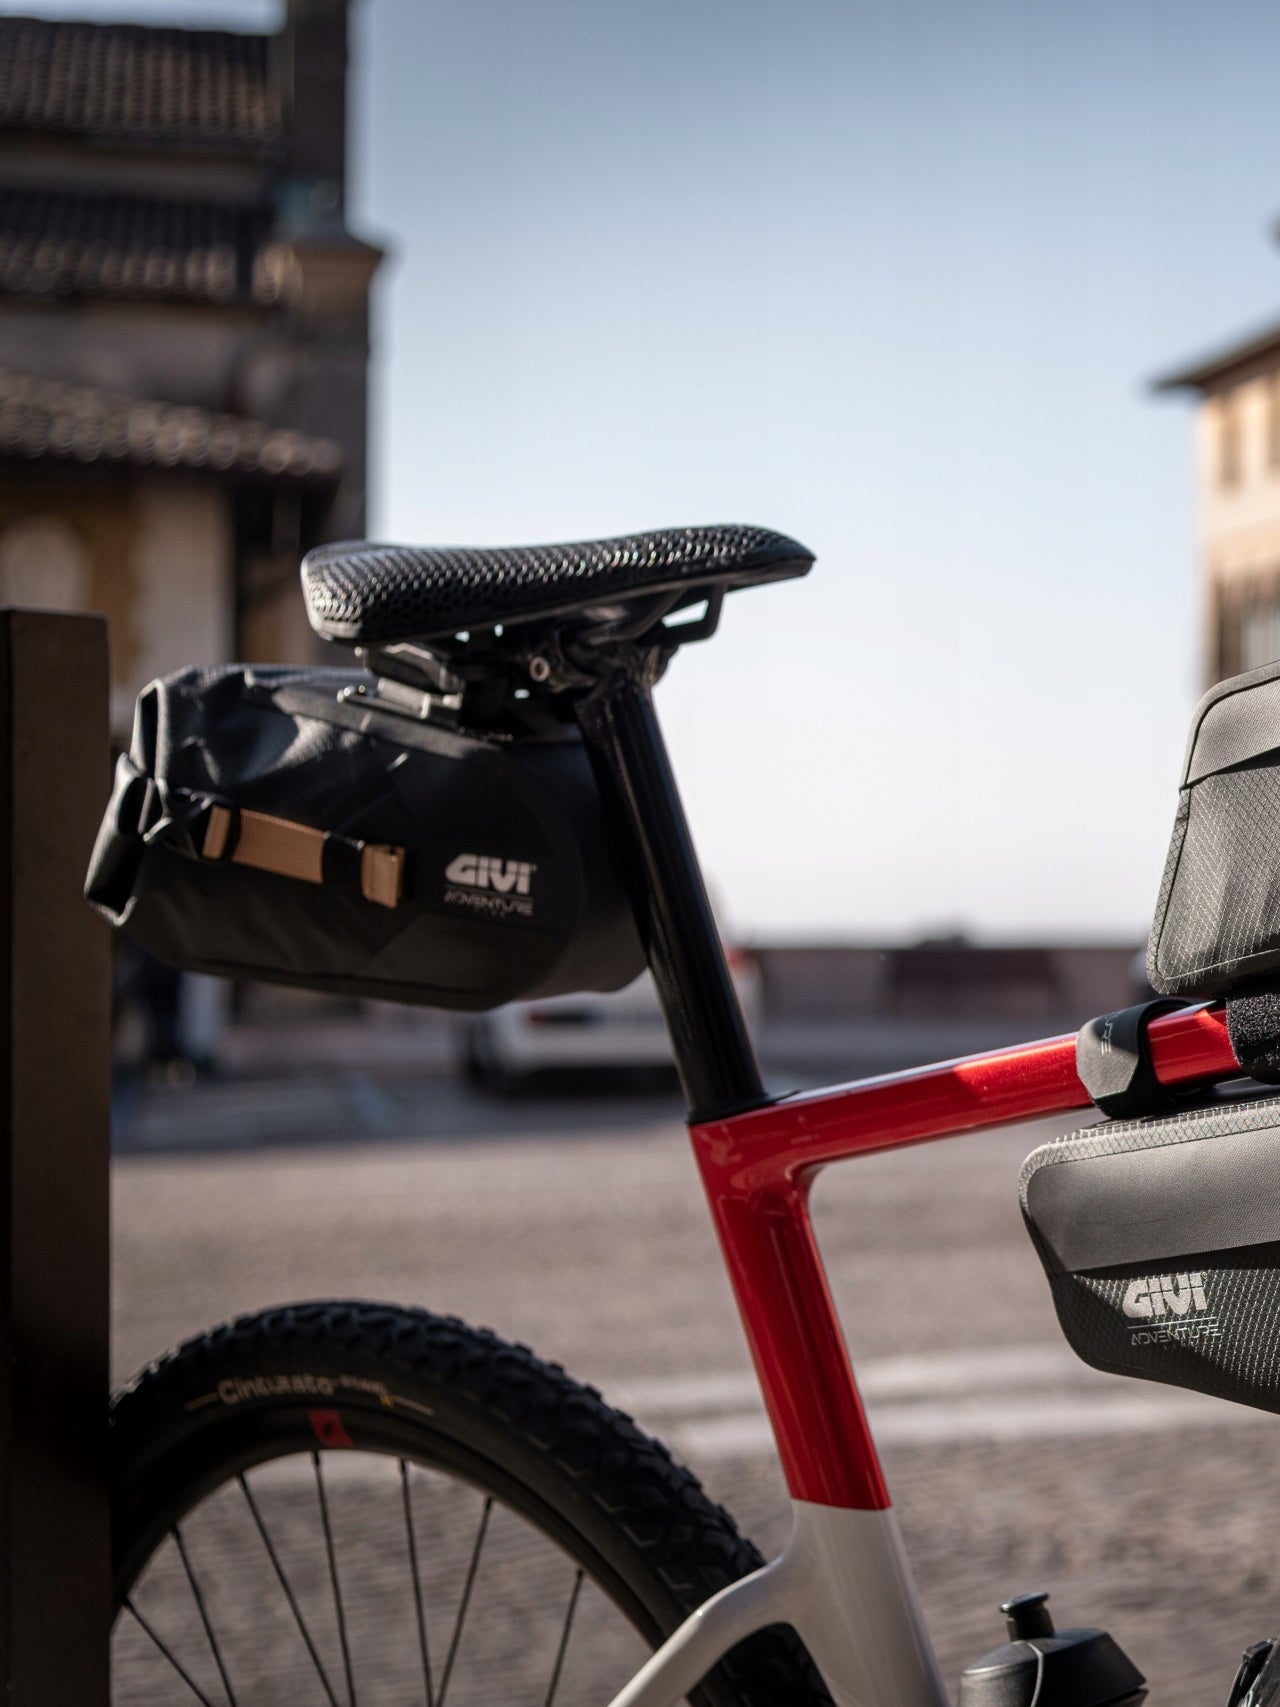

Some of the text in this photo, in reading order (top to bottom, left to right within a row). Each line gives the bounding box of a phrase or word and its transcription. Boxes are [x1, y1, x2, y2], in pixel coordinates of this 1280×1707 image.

[445, 853, 531, 895] GIVI
[1122, 1272, 1208, 1318] GIVI
[1131, 1323, 1221, 1346] ADVENTURE
